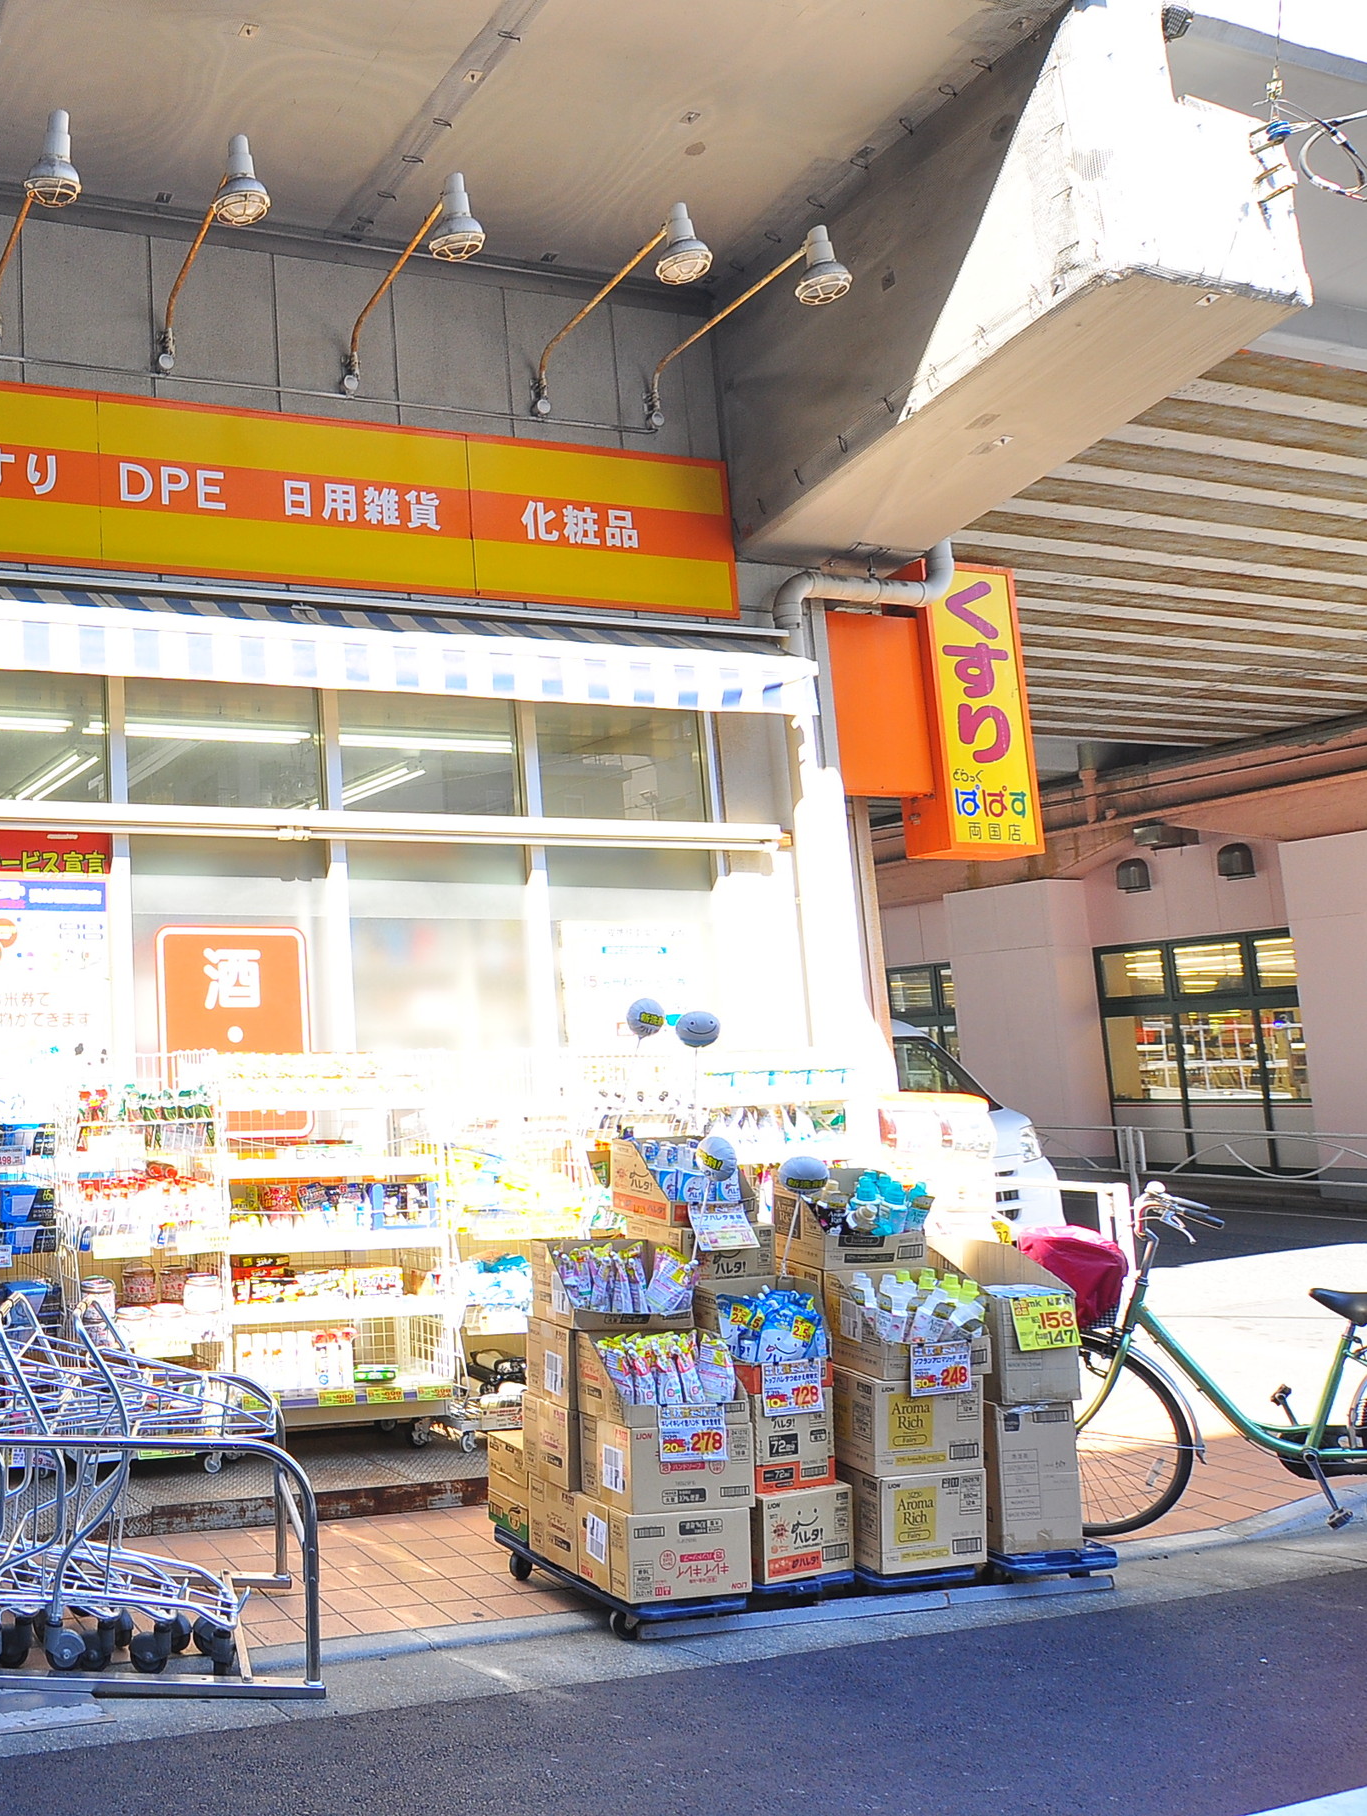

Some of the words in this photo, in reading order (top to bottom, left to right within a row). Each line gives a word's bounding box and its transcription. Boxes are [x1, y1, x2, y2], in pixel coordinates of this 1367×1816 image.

[119, 461, 227, 511] DPE
[283, 480, 442, 532] 日用雑貨
[521, 500, 639, 549] 化粧品
[942, 581, 1011, 763] くすり
[955, 784, 1027, 818] ぱぱす
[968, 821, 1022, 842] 両国店
[203, 948, 262, 1010] 酒
[715, 1261, 746, 1275] ハレタ!
[1040, 1311, 1074, 1329] 158
[1048, 1330, 1073, 1345] 147
[941, 1366, 968, 1386] 248
[791, 1385, 819, 1406] 728
[892, 1403, 930, 1415] Aroma
[772, 1418, 796, 1428] ハレタ!
[898, 1415, 924, 1430] Rich
[663, 1443, 678, 1452] 20
[690, 1431, 723, 1451] 278
[767, 1502, 781, 1510] LION
[897, 1498, 934, 1511] Aroma
[903, 1510, 928, 1525] Rich
[793, 1528, 824, 1545] ハレタ!
[676, 1562, 729, 1579] キレイキレイ
[731, 1581, 748, 1589] LION
